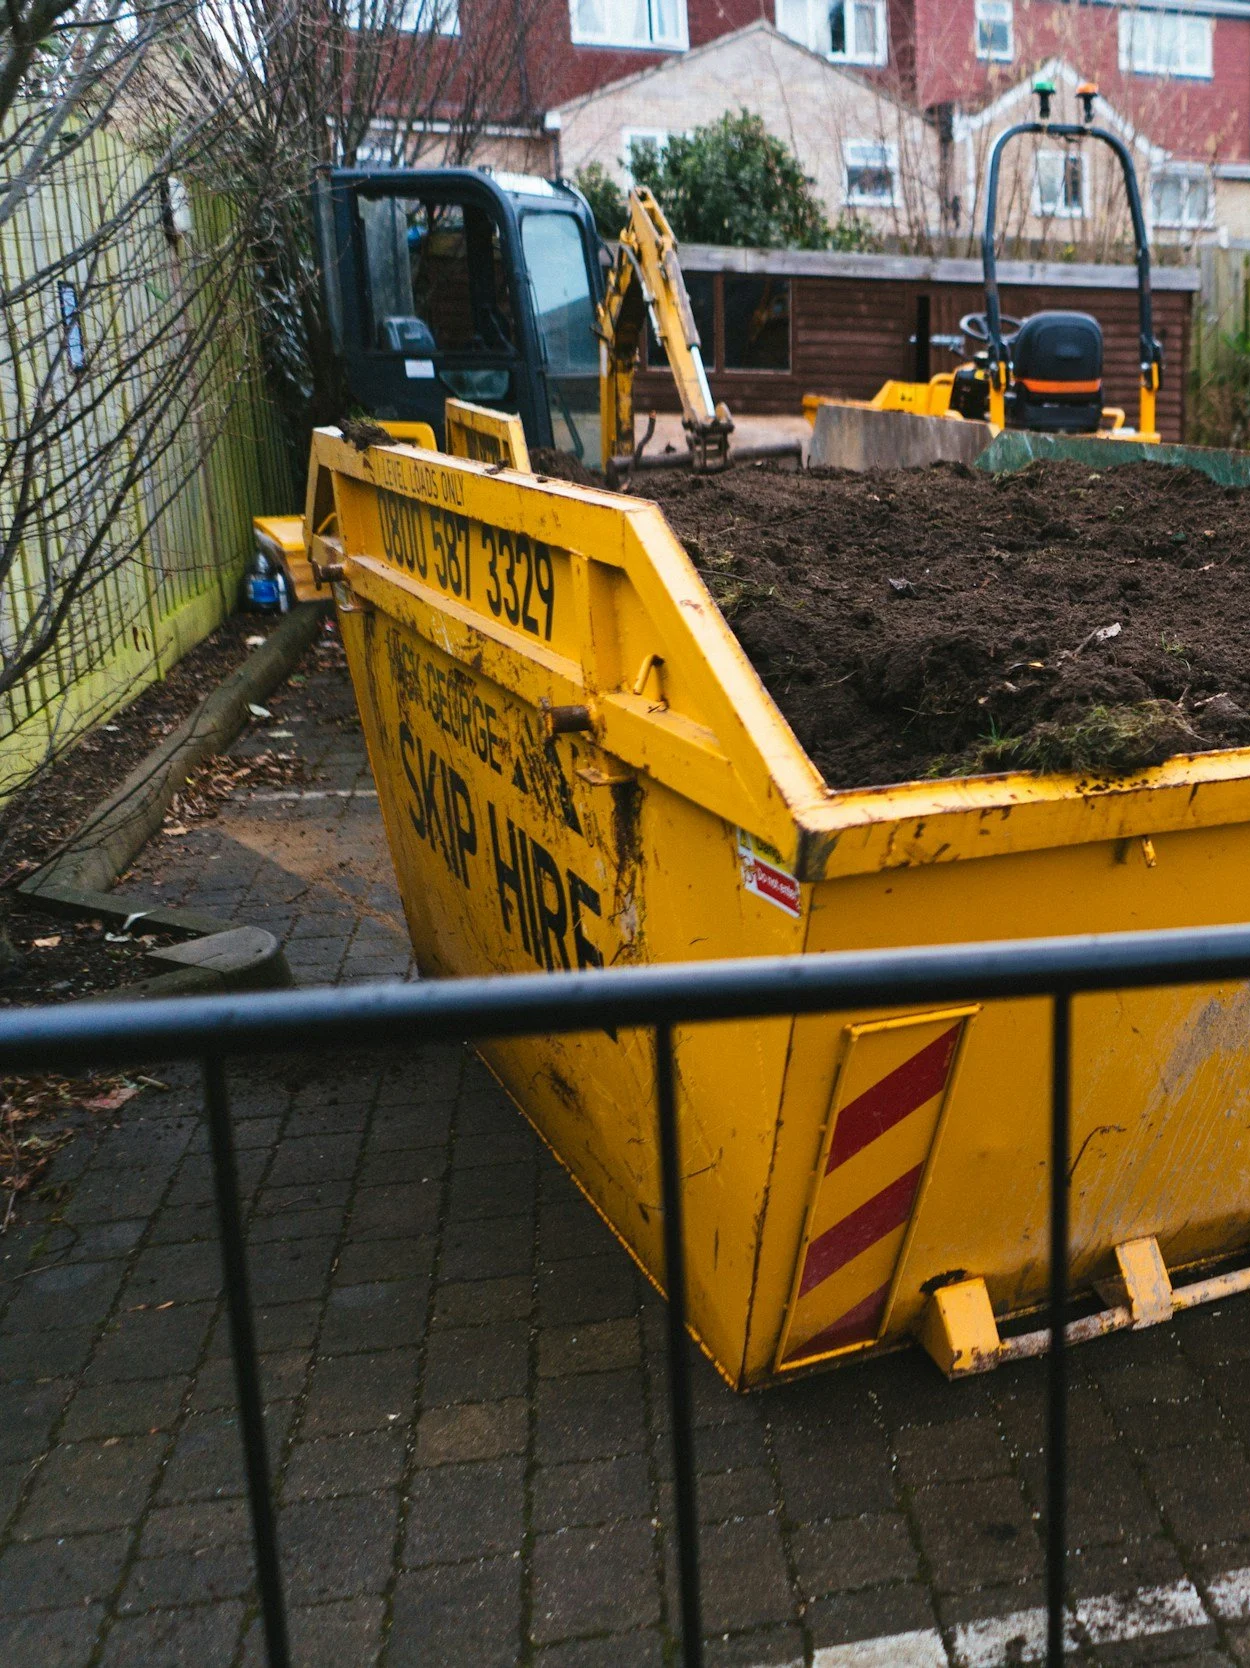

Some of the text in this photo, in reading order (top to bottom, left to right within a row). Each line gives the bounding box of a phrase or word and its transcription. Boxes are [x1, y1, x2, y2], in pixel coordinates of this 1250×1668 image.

[382, 456, 465, 506] LEVEL LOADS ONLY
[377, 487, 554, 642] 0800 587 3329
[425, 661, 502, 775] GEORGE
[400, 721, 477, 890] SKIP
[757, 867, 767, 883] Do
[768, 876, 780, 891] not
